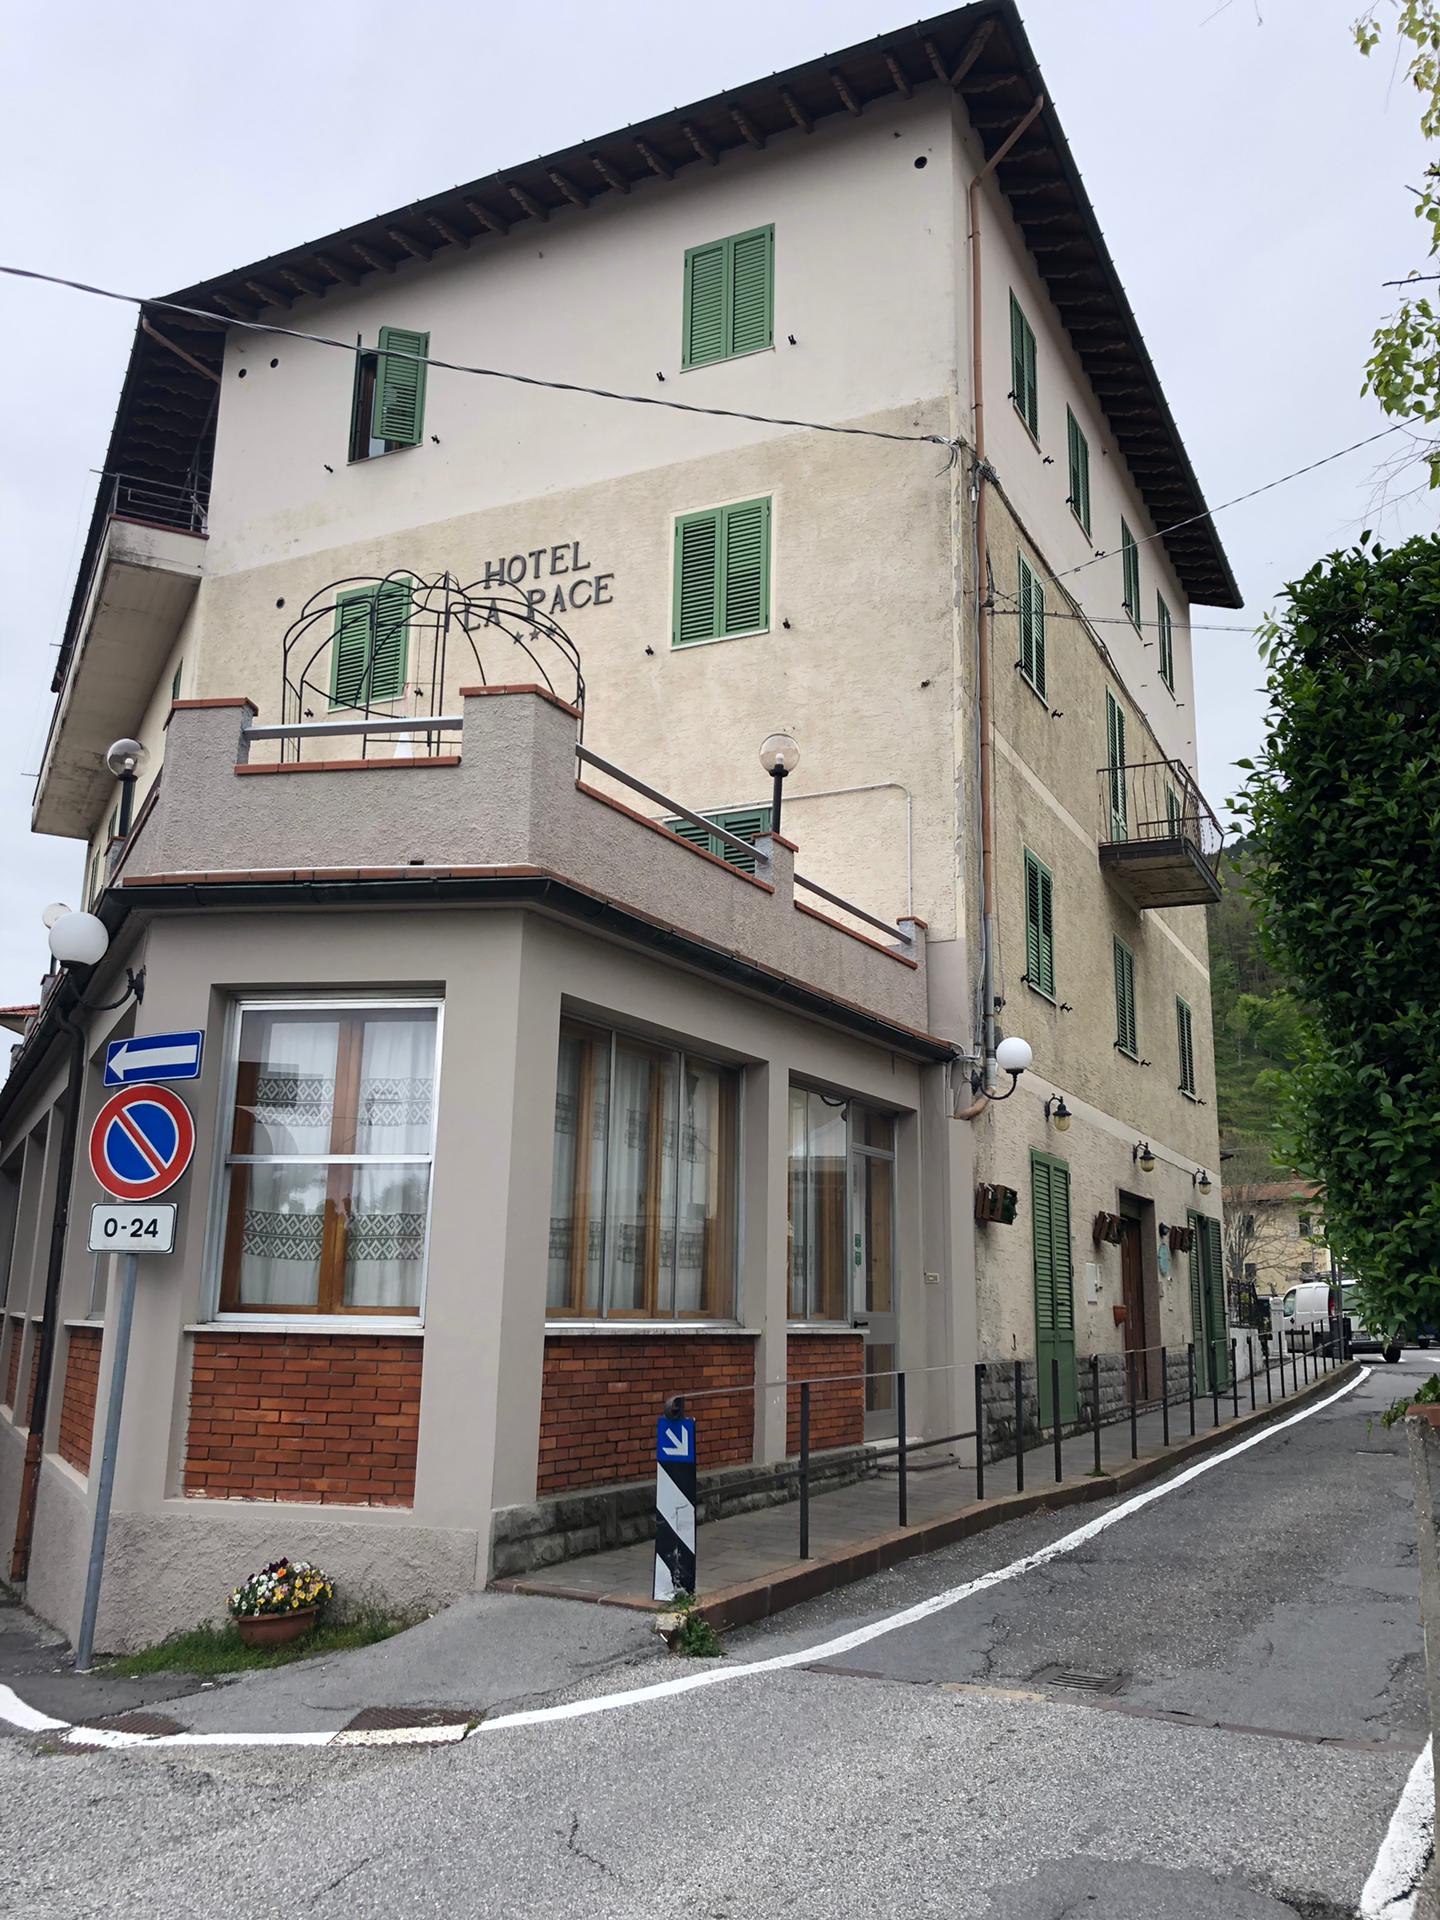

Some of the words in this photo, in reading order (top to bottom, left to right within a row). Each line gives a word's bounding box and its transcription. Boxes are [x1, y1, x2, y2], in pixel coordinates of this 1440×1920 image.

[484, 541, 591, 590] HOTEL
[463, 598, 501, 633] LA
[526, 573, 615, 621] PACE
[104, 1217, 159, 1238] 0-24
